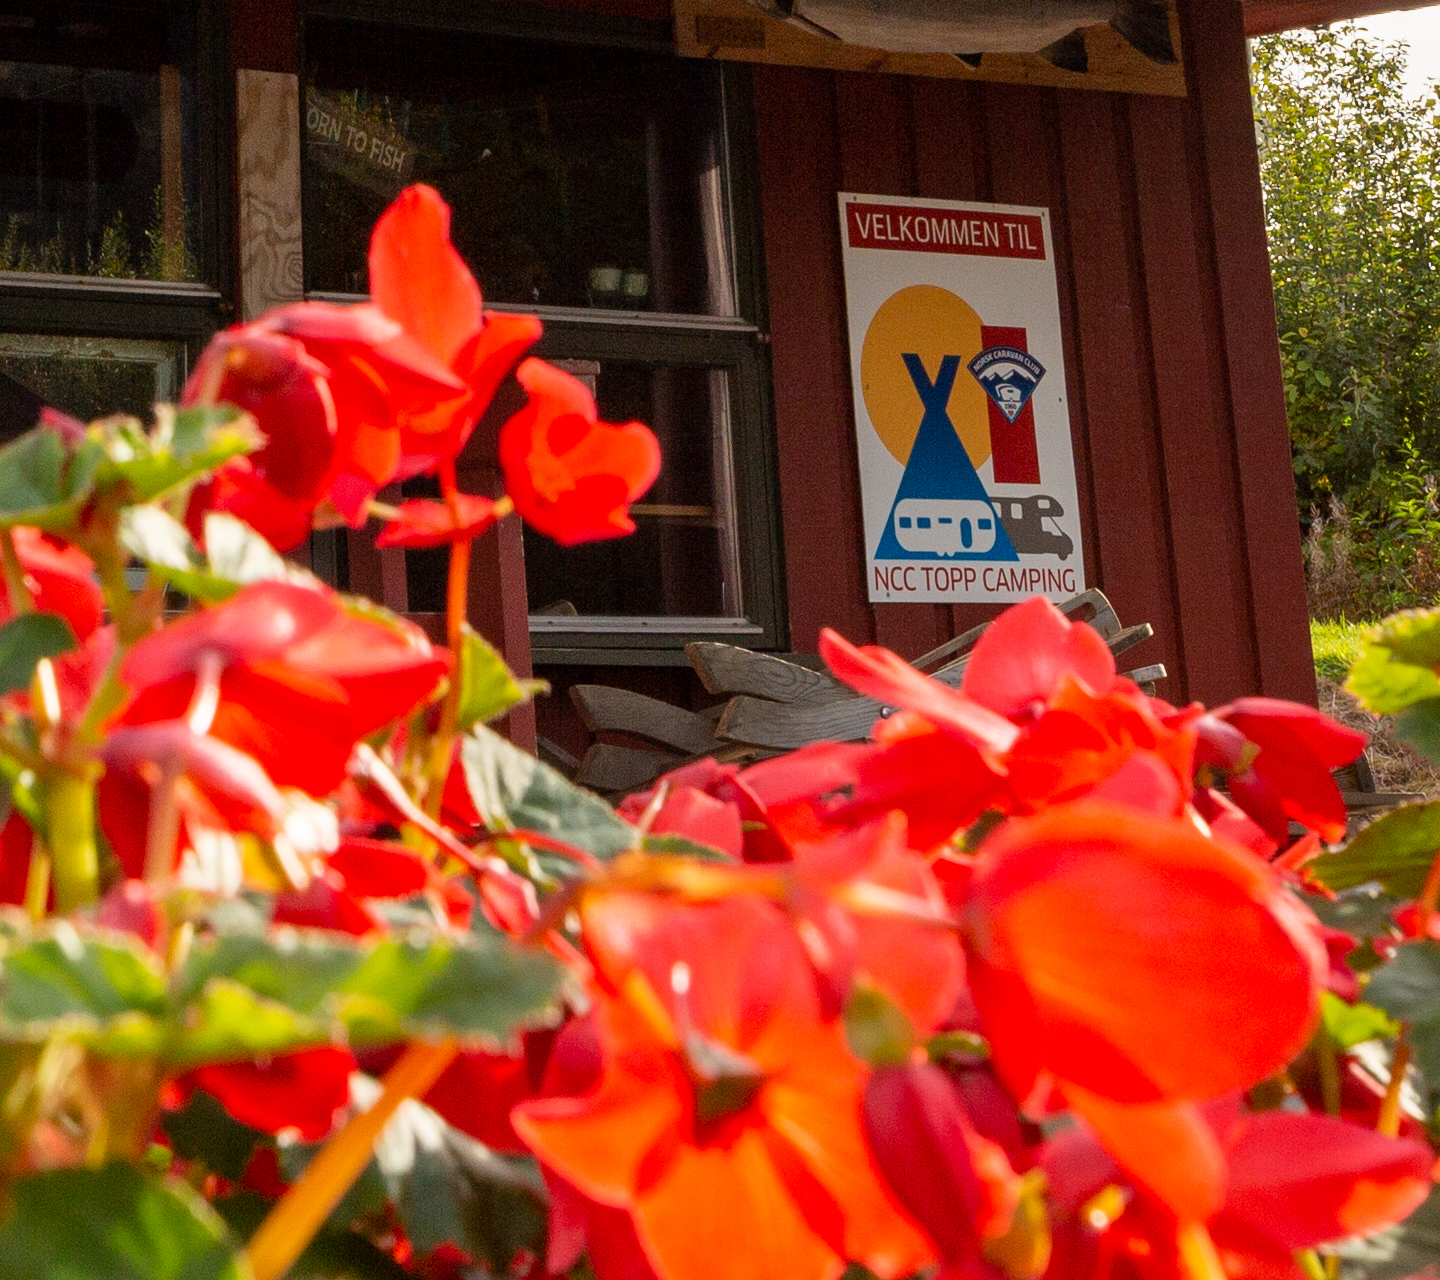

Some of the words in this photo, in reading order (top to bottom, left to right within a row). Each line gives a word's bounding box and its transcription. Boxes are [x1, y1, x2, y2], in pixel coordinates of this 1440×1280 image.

[306, 107, 342, 142] ORN
[346, 124, 368, 153] TO
[369, 136, 406, 173] FISH
[855, 212, 1000, 248] VELKOMMEN
[1004, 222, 1038, 251] TIL
[973, 354, 994, 373] NORSK
[993, 349, 1024, 363] CARAVAN
[1024, 358, 1041, 376] CLUB
[874, 566, 917, 592] NCC
[920, 566, 977, 592] TOPP
[982, 567, 1077, 594] CAMPING
